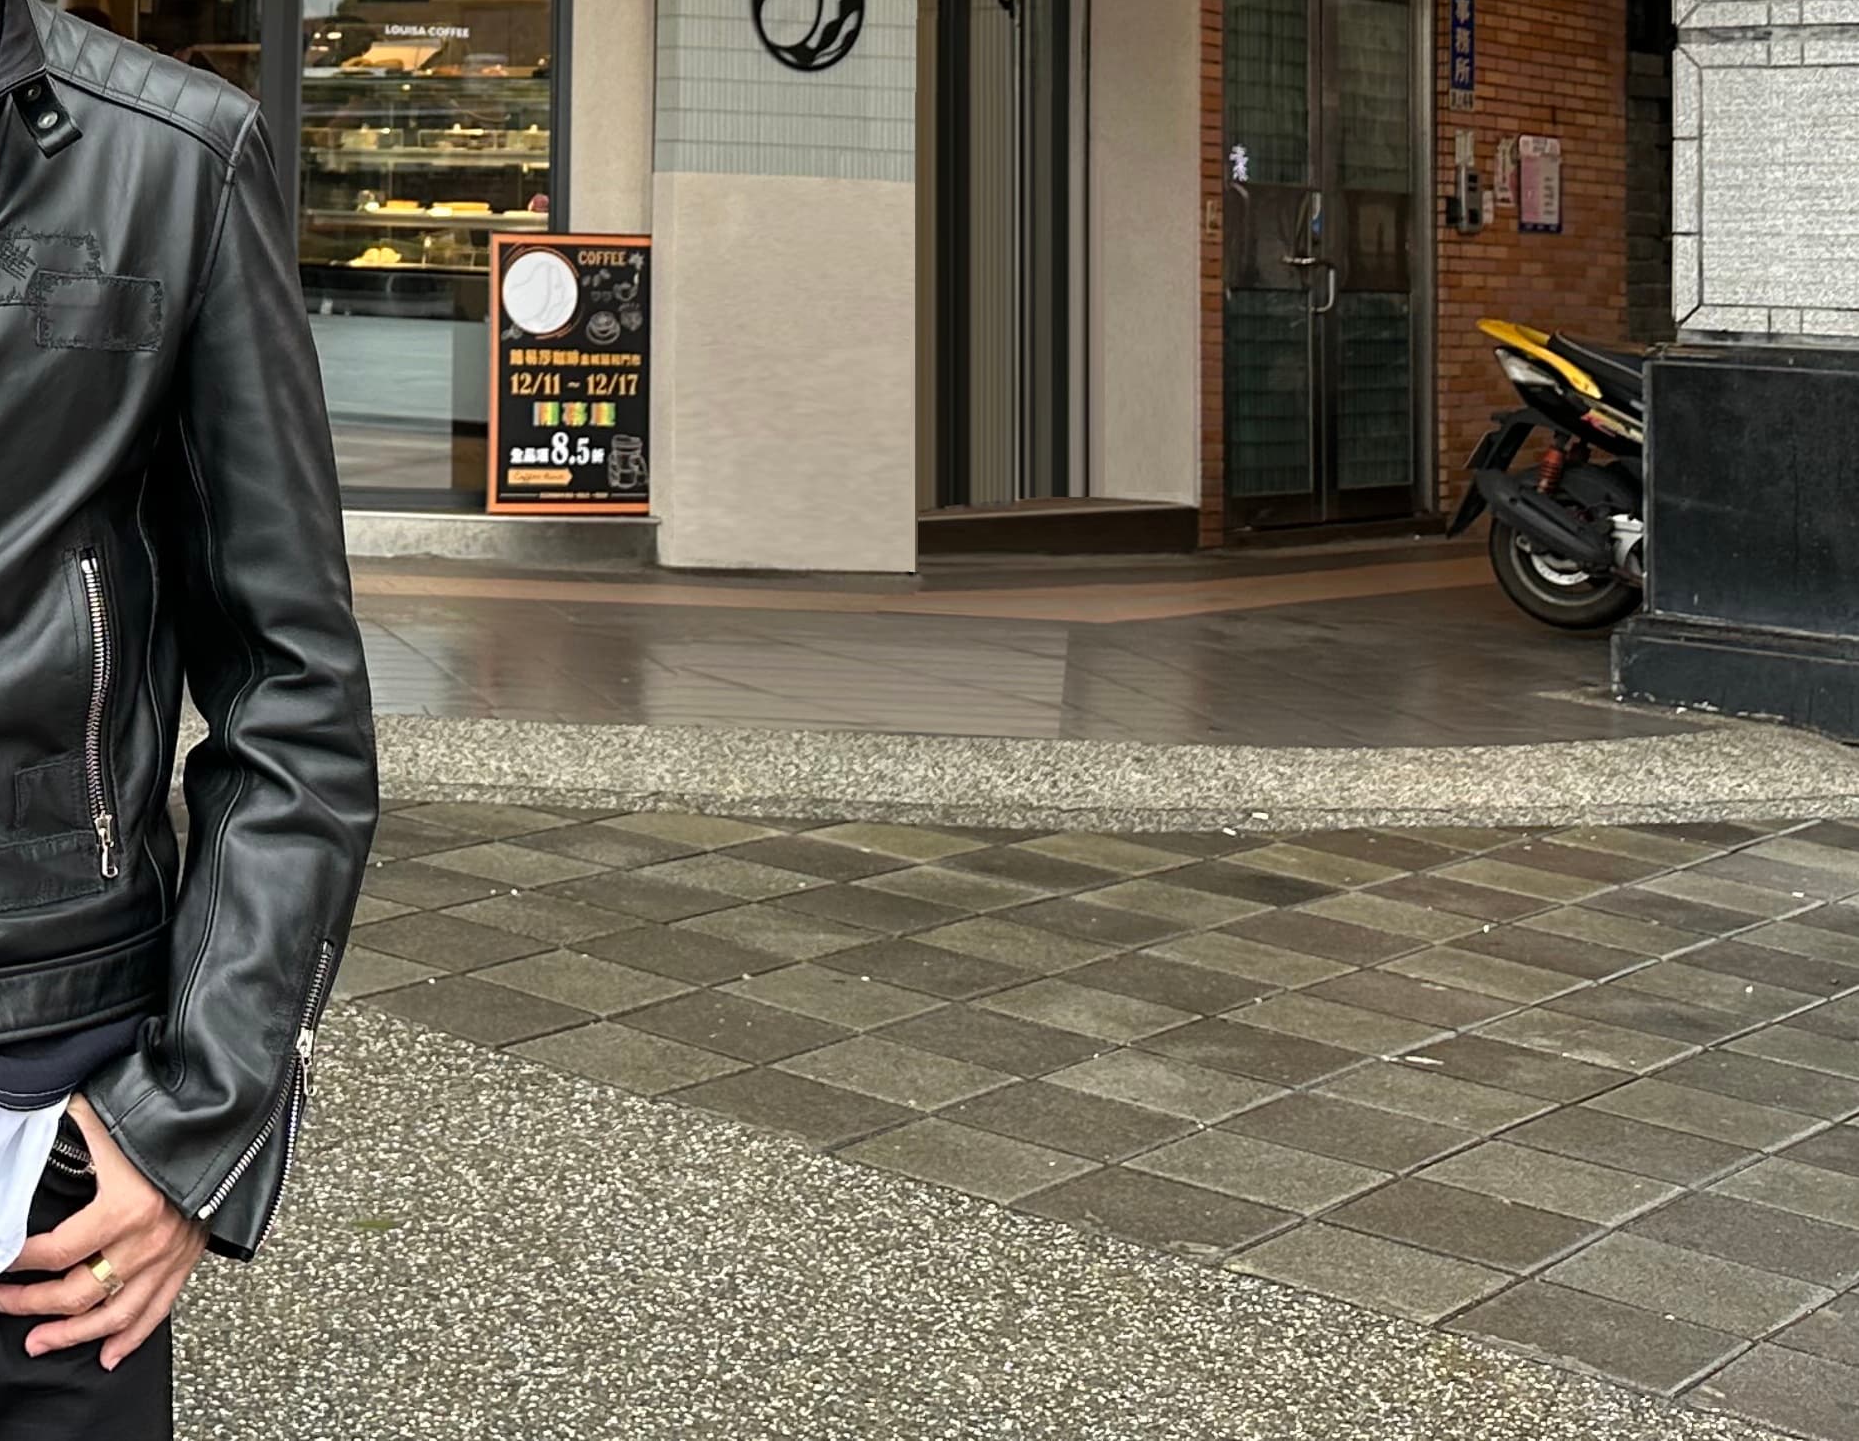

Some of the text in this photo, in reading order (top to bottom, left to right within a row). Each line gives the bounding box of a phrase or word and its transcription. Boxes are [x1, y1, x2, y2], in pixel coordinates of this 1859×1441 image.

[384, 24, 470, 39] LOUISA COFFEE
[577, 250, 627, 267] COFFEE
[510, 371, 561, 396] 12/11
[586, 372, 639, 396] 12/17
